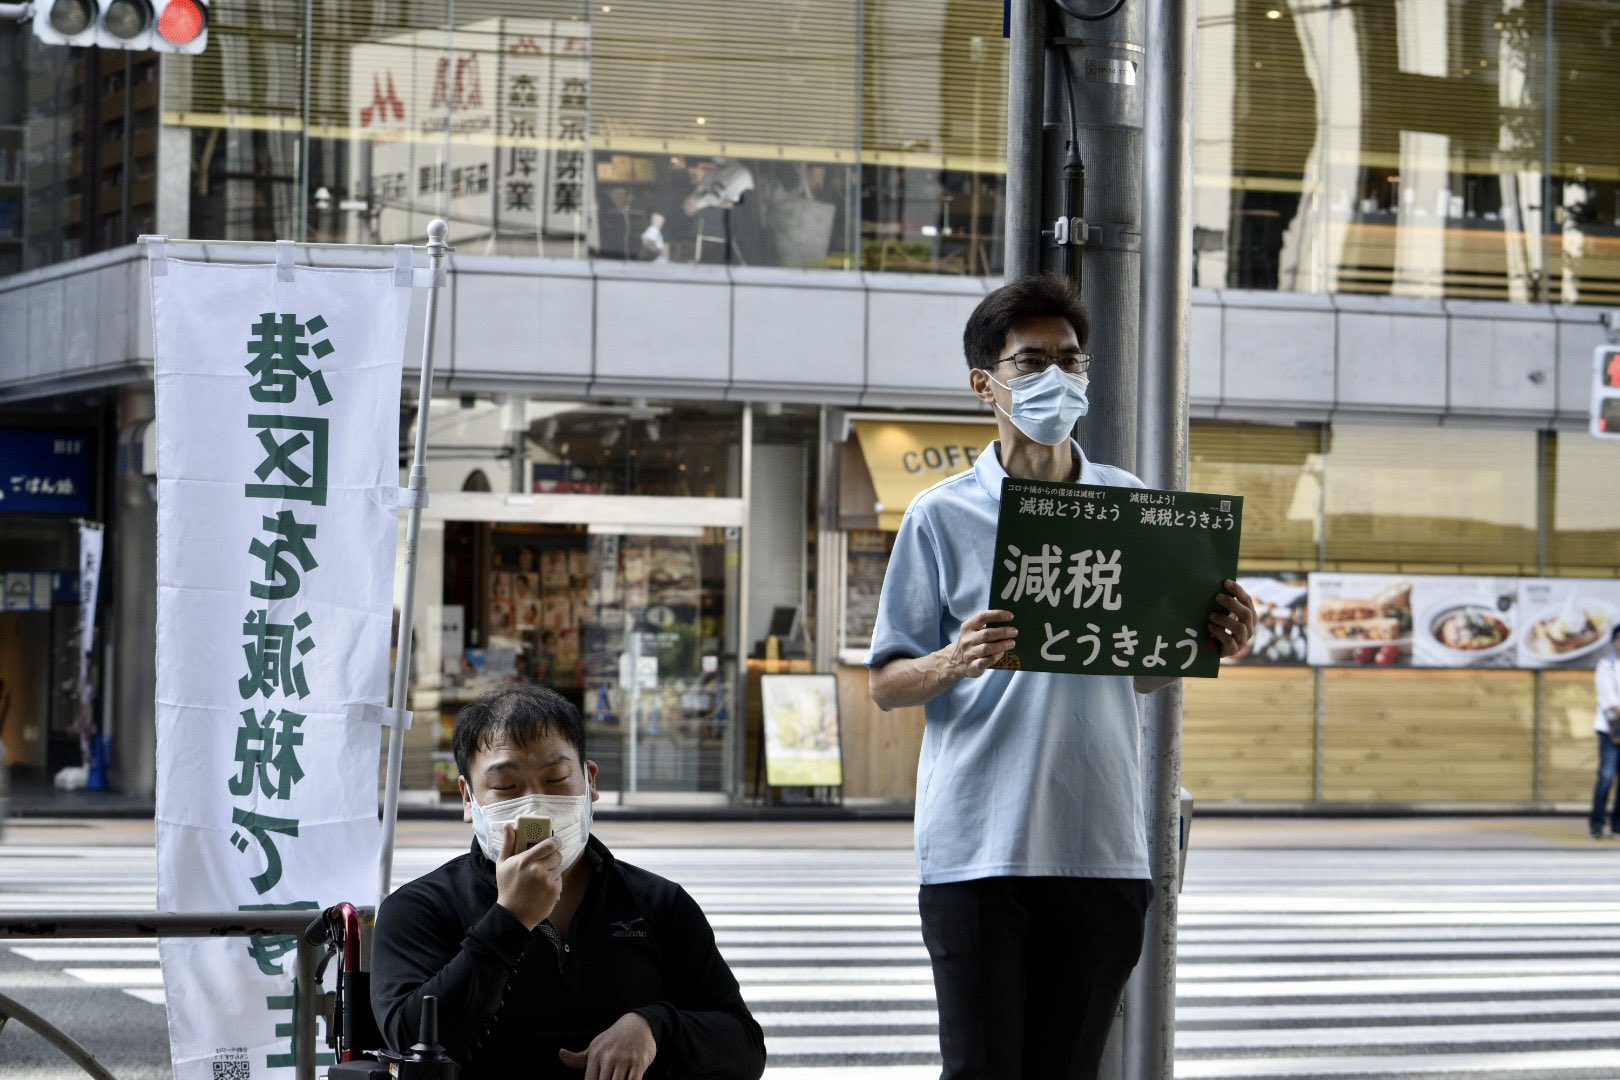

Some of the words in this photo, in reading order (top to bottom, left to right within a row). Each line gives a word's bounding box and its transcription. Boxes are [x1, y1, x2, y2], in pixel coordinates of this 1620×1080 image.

[1019, 497, 1120, 522] 減税とうきょう
[1140, 507, 1234, 531] 減税とうきょう
[1001, 543, 1122, 611] 減税
[1040, 623, 1198, 670] とうきょう
